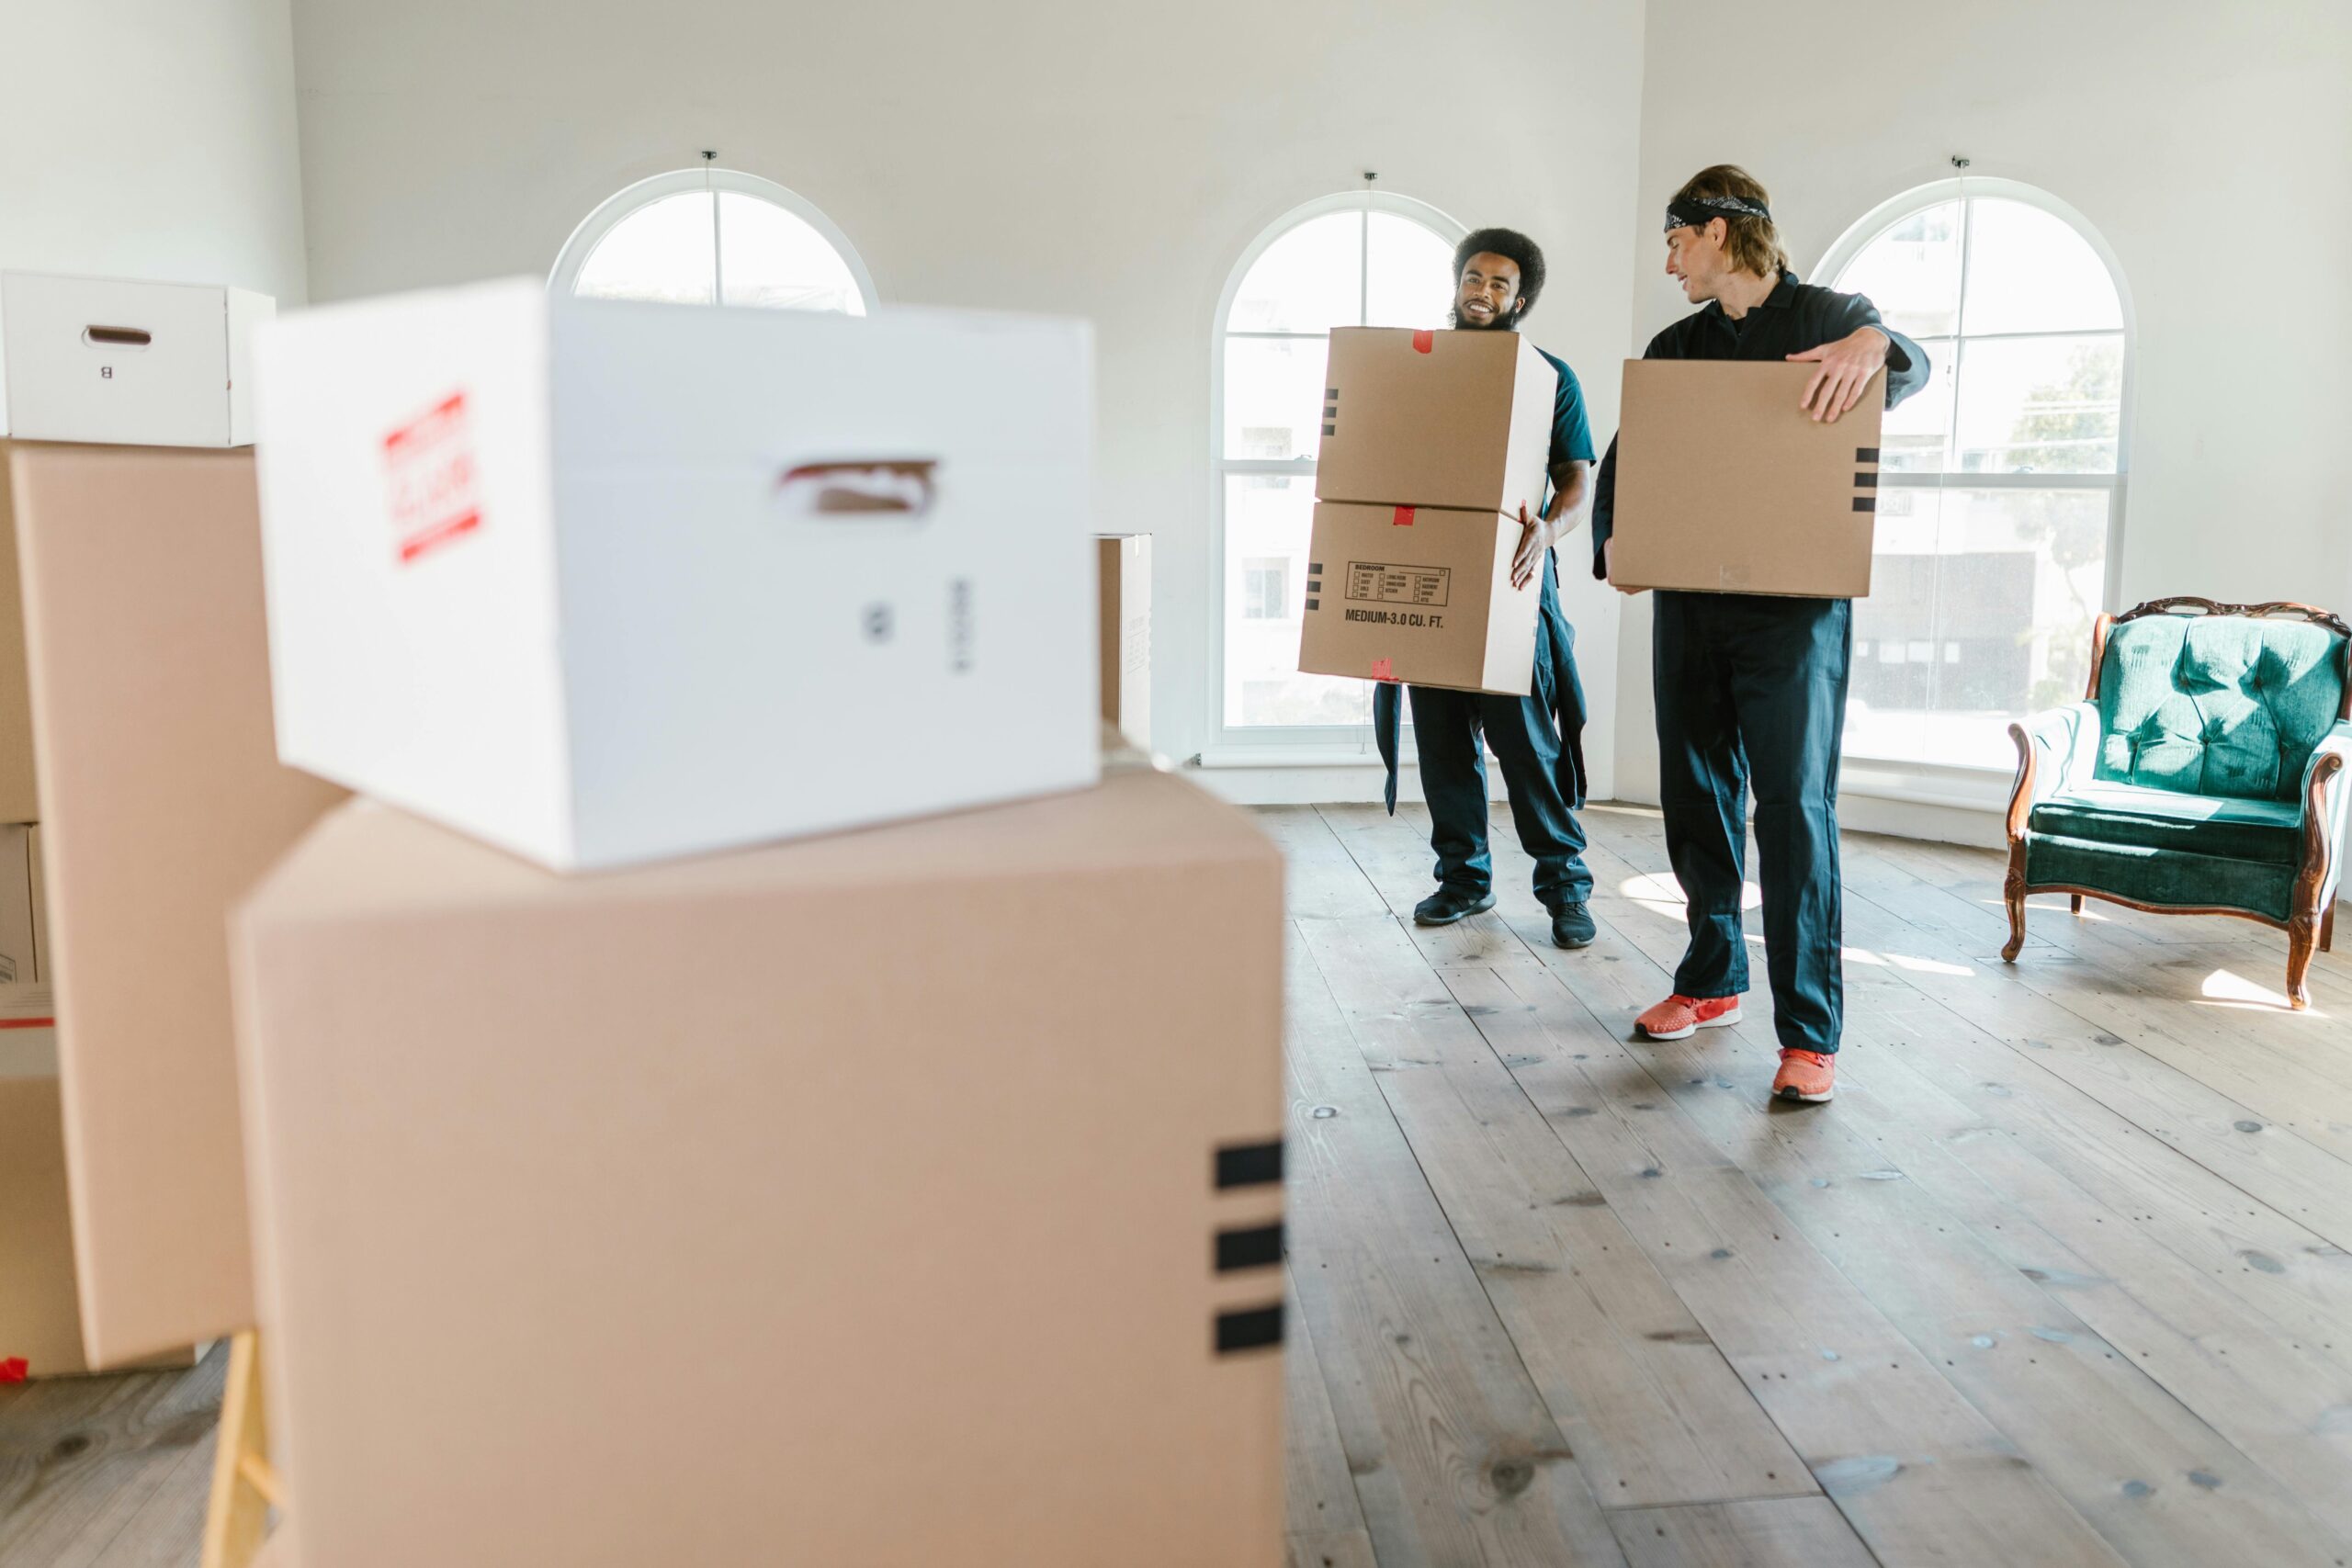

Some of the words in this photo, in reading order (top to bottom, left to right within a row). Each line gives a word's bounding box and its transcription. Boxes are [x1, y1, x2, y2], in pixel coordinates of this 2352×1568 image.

[1345, 609, 1407, 625] MEDIUM-3.0
[1409, 614, 1426, 626] CU.
[1430, 615, 1443, 627] FT.
